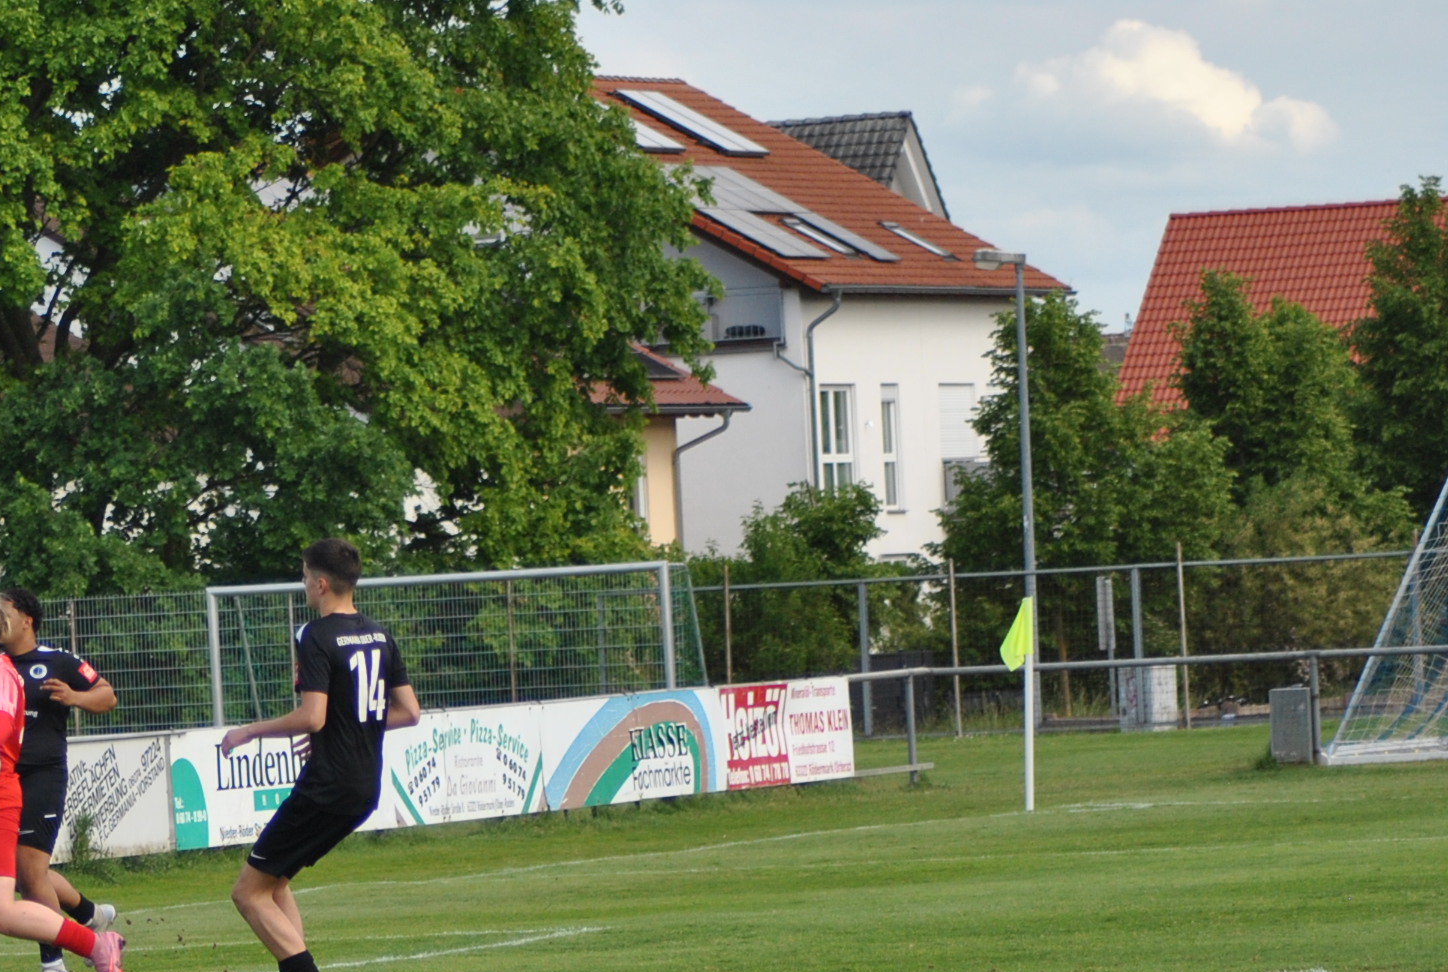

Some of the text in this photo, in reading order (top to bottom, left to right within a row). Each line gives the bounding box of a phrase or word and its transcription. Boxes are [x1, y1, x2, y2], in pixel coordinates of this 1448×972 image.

[349, 649, 386, 723] 14
[628, 725, 689, 762] KLASSE
[790, 708, 849, 735] THOMAS KLEIN
[405, 718, 529, 775] Pizza-Service Pizza-Service
[62, 744, 117, 825] ERBEFLÄCHEN
[632, 761, 691, 791] Fachmärkte
